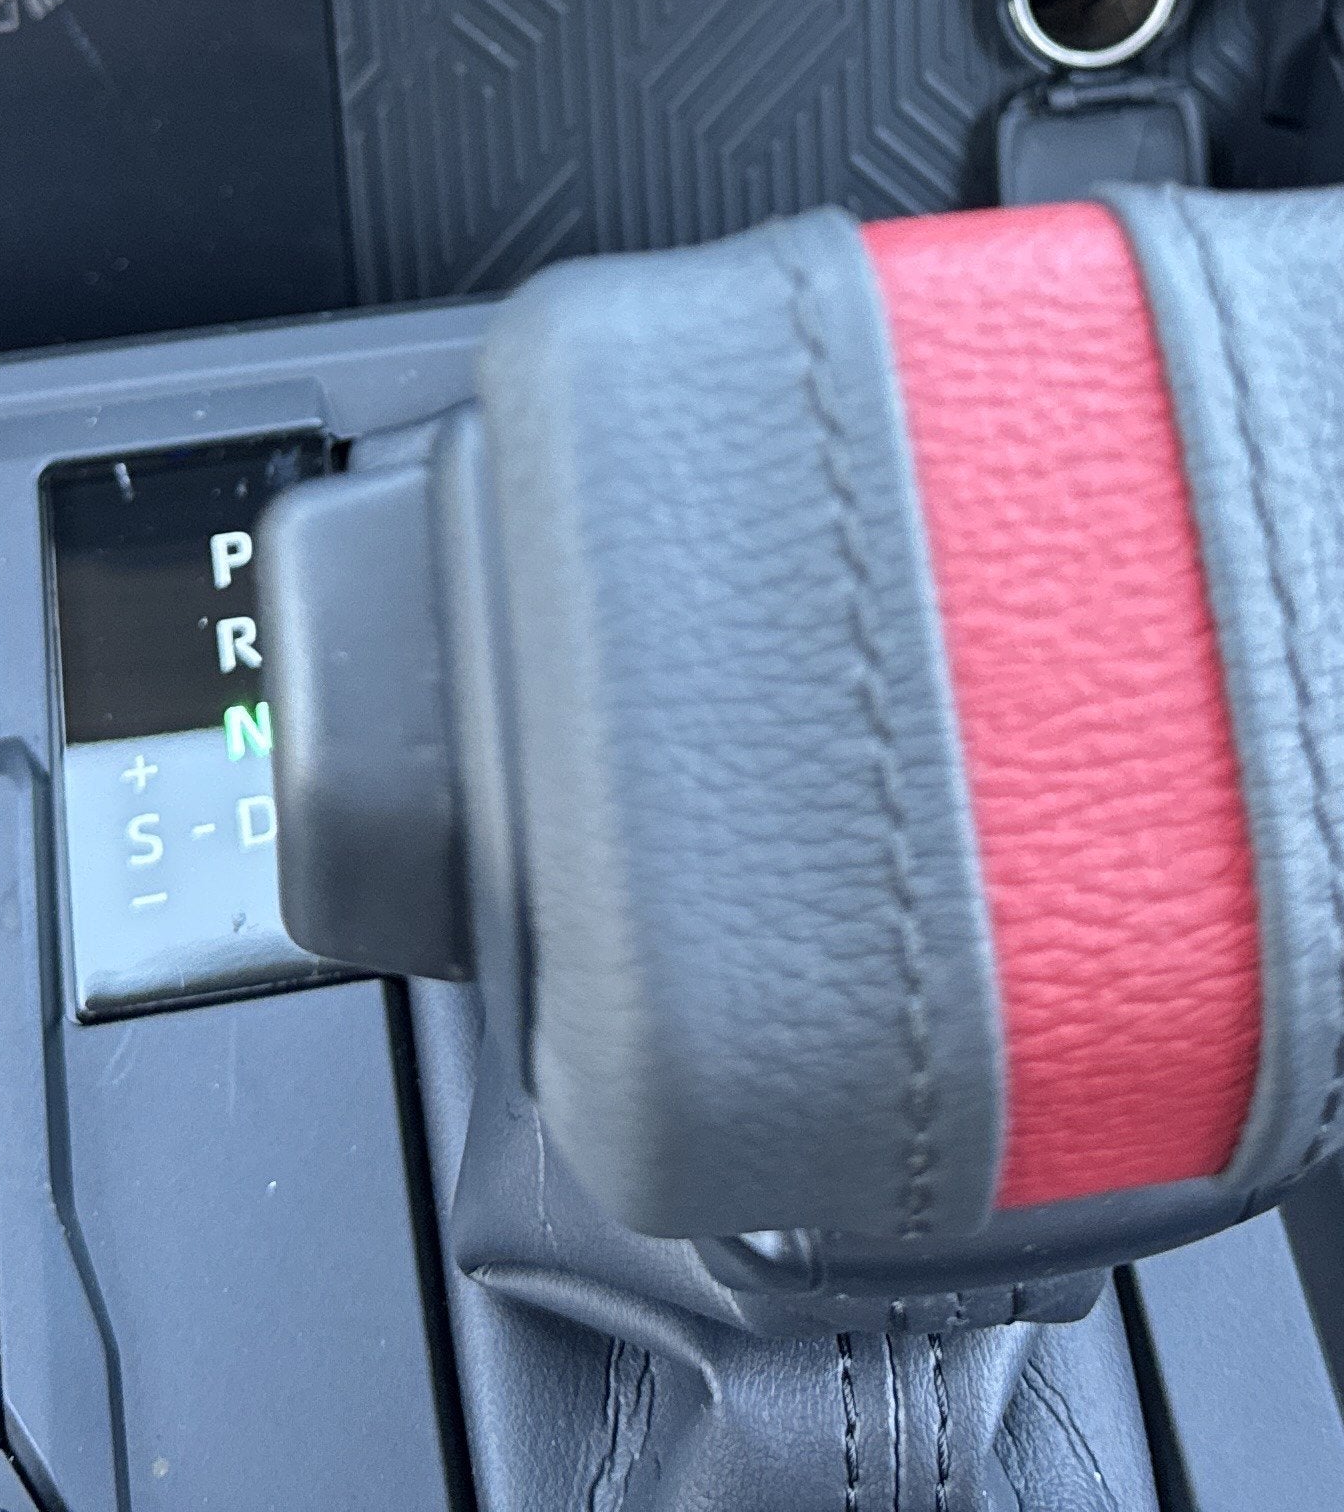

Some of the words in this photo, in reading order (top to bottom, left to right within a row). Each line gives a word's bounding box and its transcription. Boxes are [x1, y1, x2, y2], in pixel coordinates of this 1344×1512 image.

[209, 530, 253, 590] P
[216, 616, 263, 674] R
[223, 700, 273, 763] N
[127, 813, 164, 867] S
[235, 795, 278, 851] D
